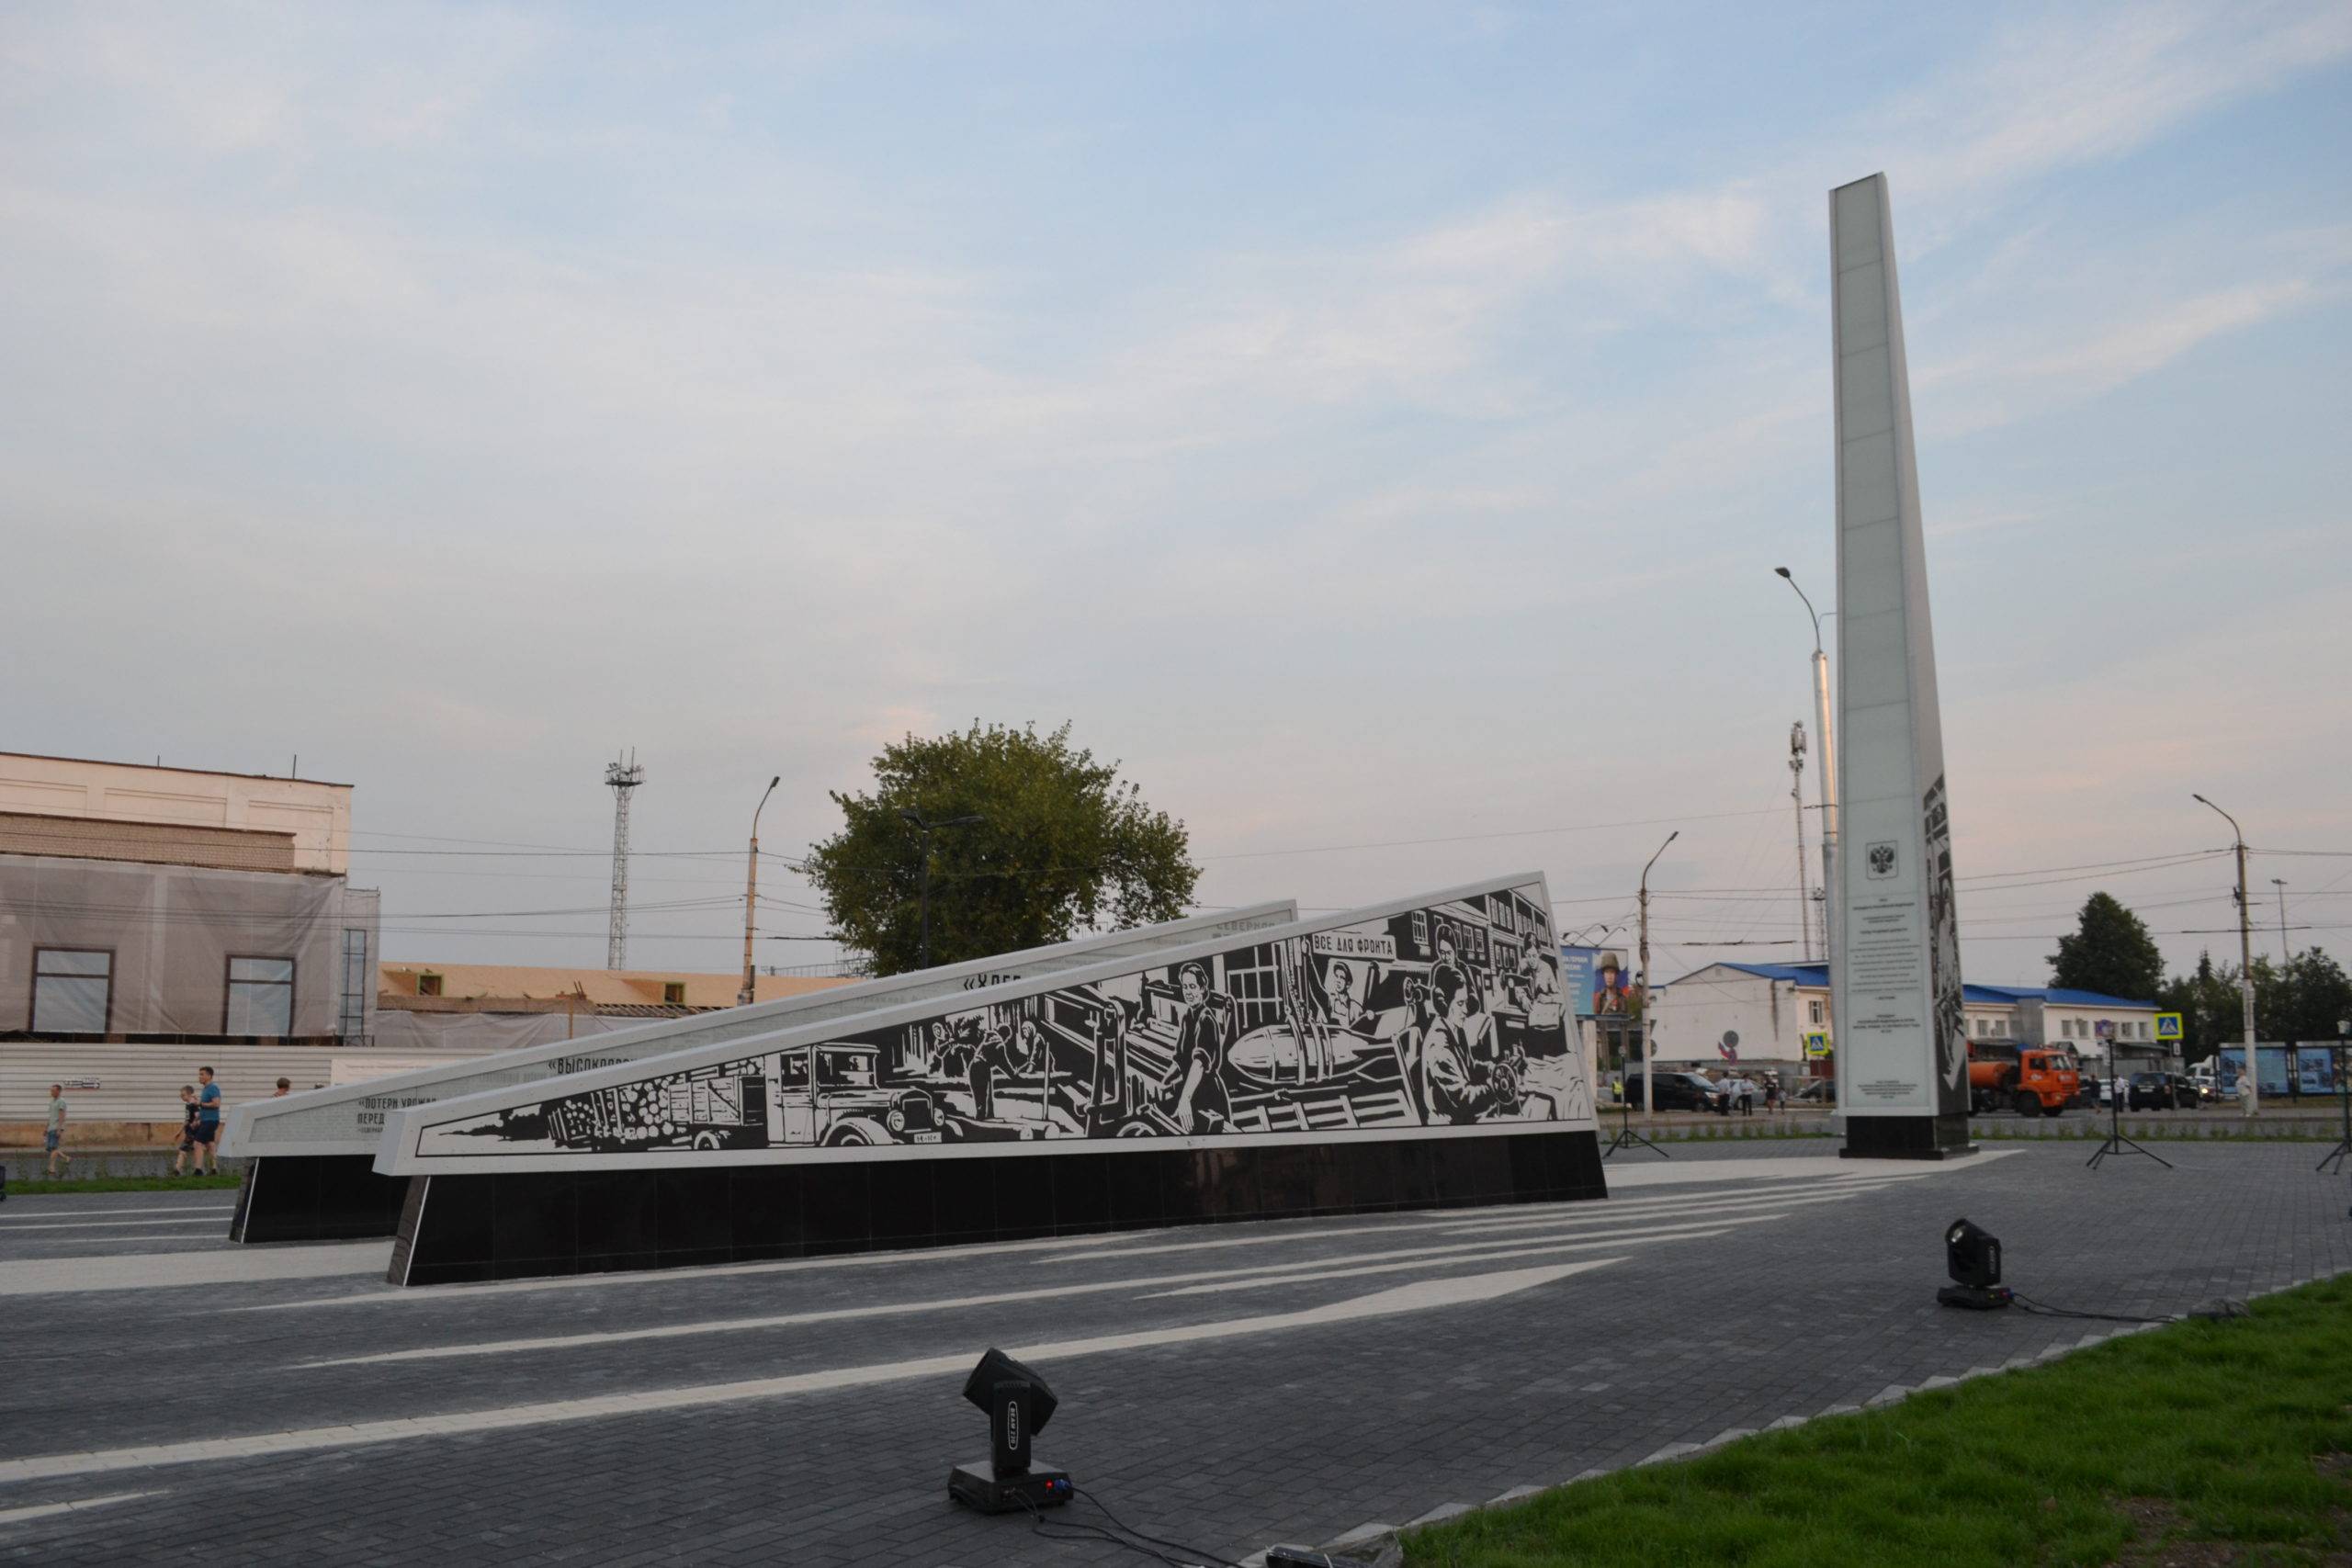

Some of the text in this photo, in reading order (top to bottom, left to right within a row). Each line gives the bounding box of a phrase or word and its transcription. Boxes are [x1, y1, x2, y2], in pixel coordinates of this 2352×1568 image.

[1314, 934, 1393, 955] ВСЕ ДЛЯ ФРОНТА
[357, 1112, 385, 1124] ПЕРЕД
